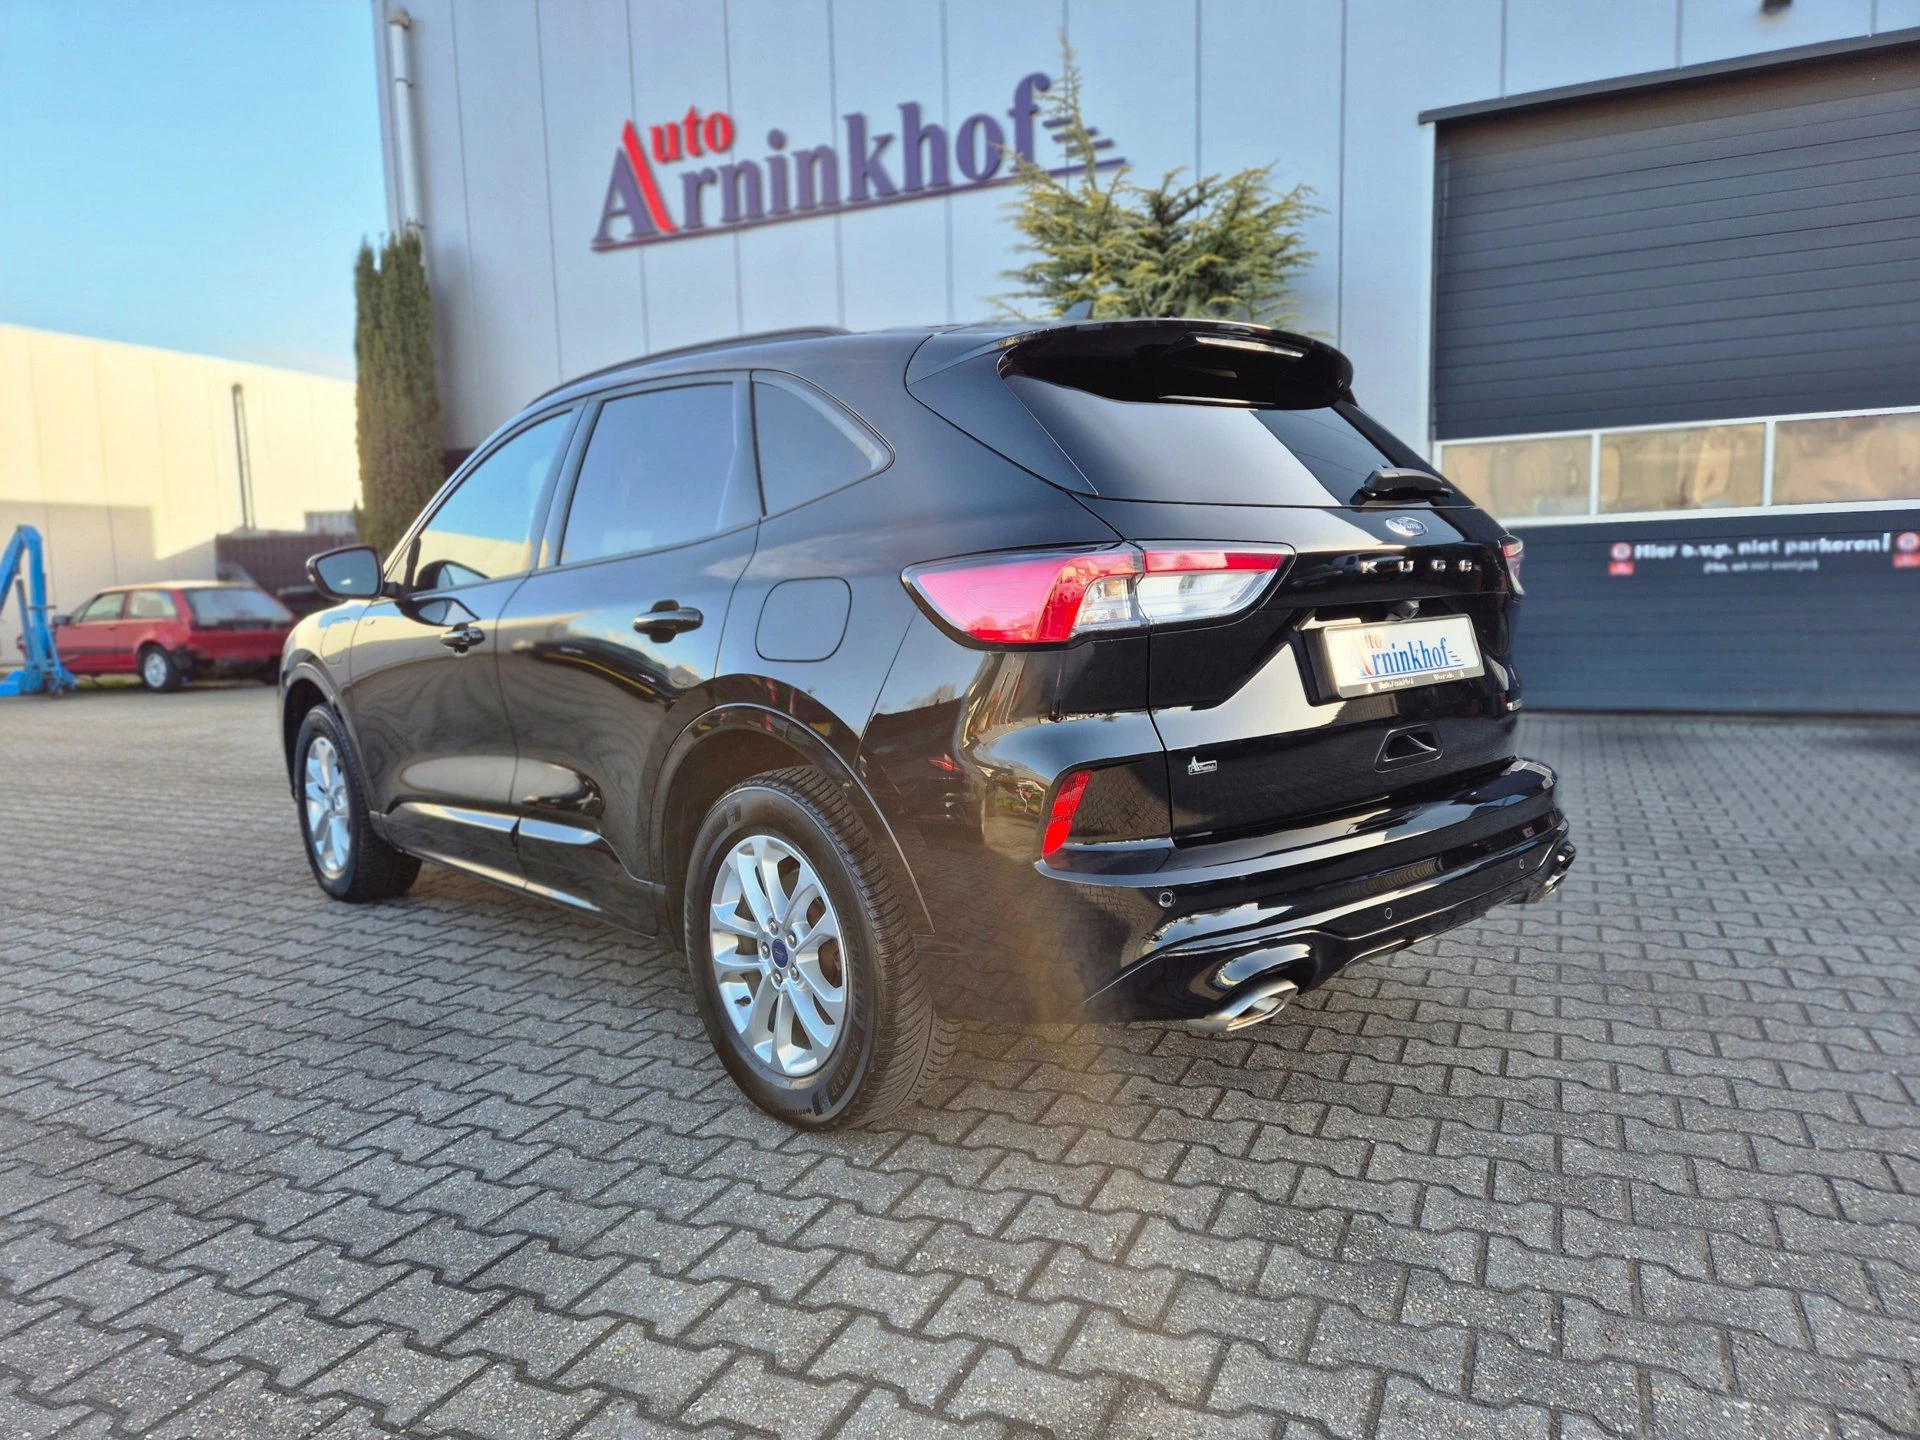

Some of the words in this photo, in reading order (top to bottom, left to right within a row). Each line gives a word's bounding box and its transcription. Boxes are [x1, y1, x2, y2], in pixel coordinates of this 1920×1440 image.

[591, 72, 1051, 246] Arninkhof
[1634, 543, 1677, 560] Hier
[1737, 538, 1778, 556] niet
